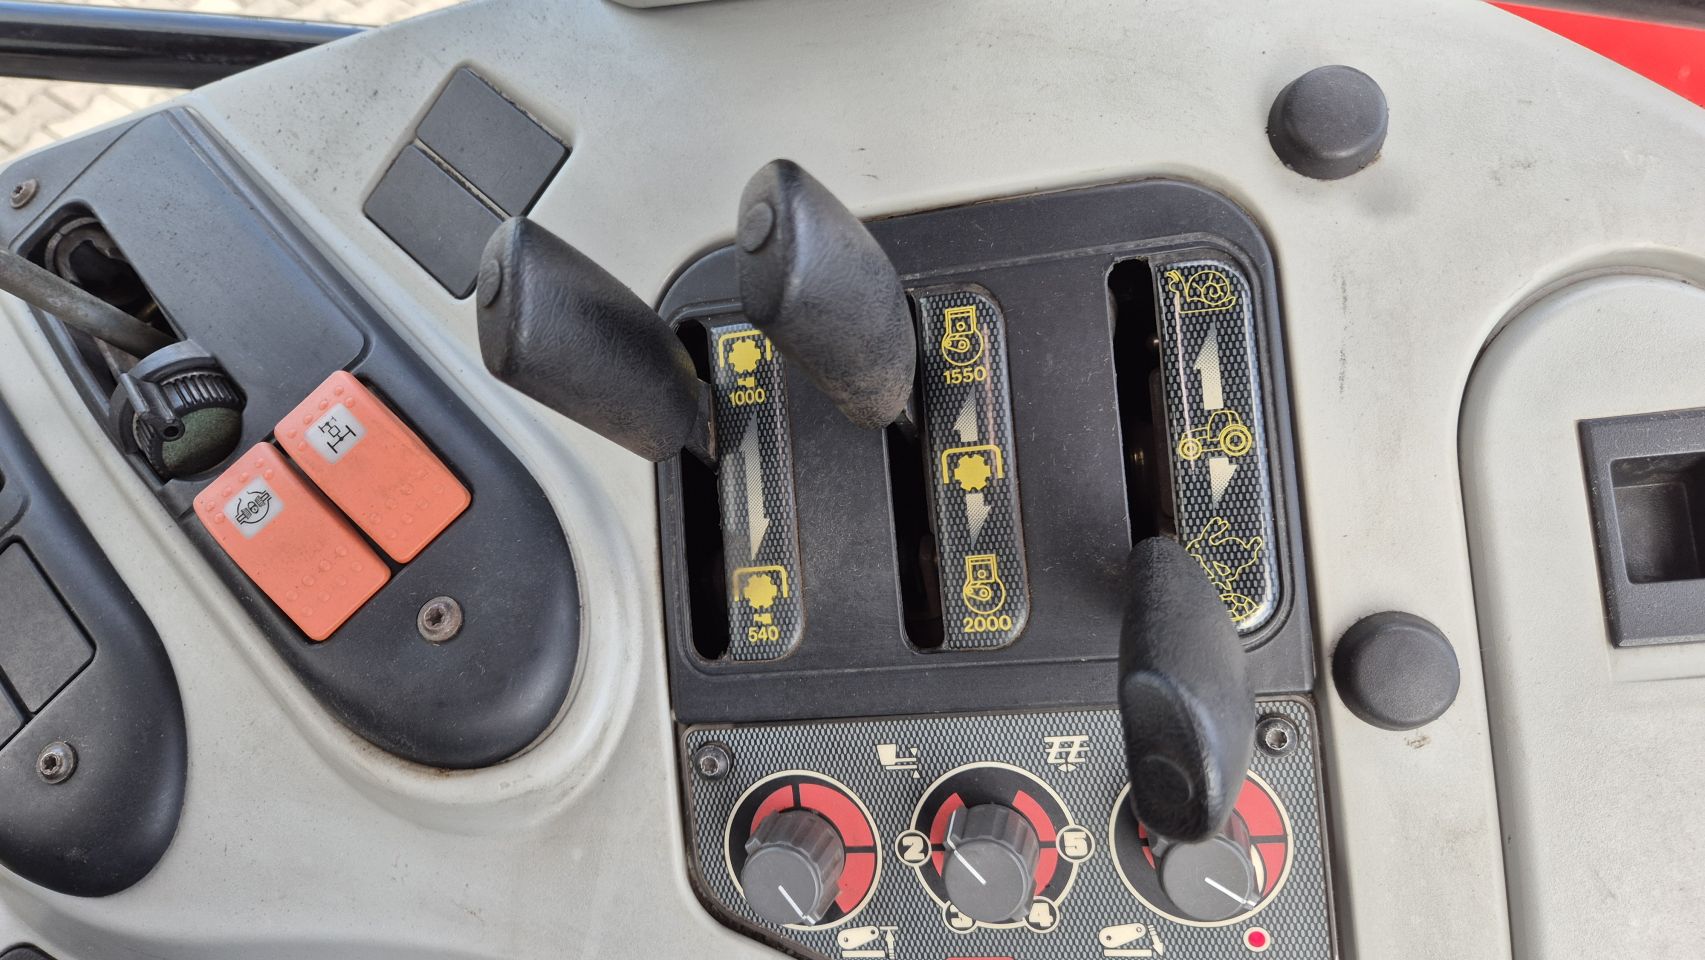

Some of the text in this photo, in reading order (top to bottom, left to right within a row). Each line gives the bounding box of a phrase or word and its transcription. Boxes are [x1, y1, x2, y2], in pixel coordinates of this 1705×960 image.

[943, 366, 987, 385] 1550
[728, 388, 766, 407] 1000
[963, 615, 1012, 633] 2000
[747, 626, 779, 643] 540
[902, 835, 925, 862] 2
[1063, 831, 1089, 857] 5
[1028, 902, 1054, 928] 4
